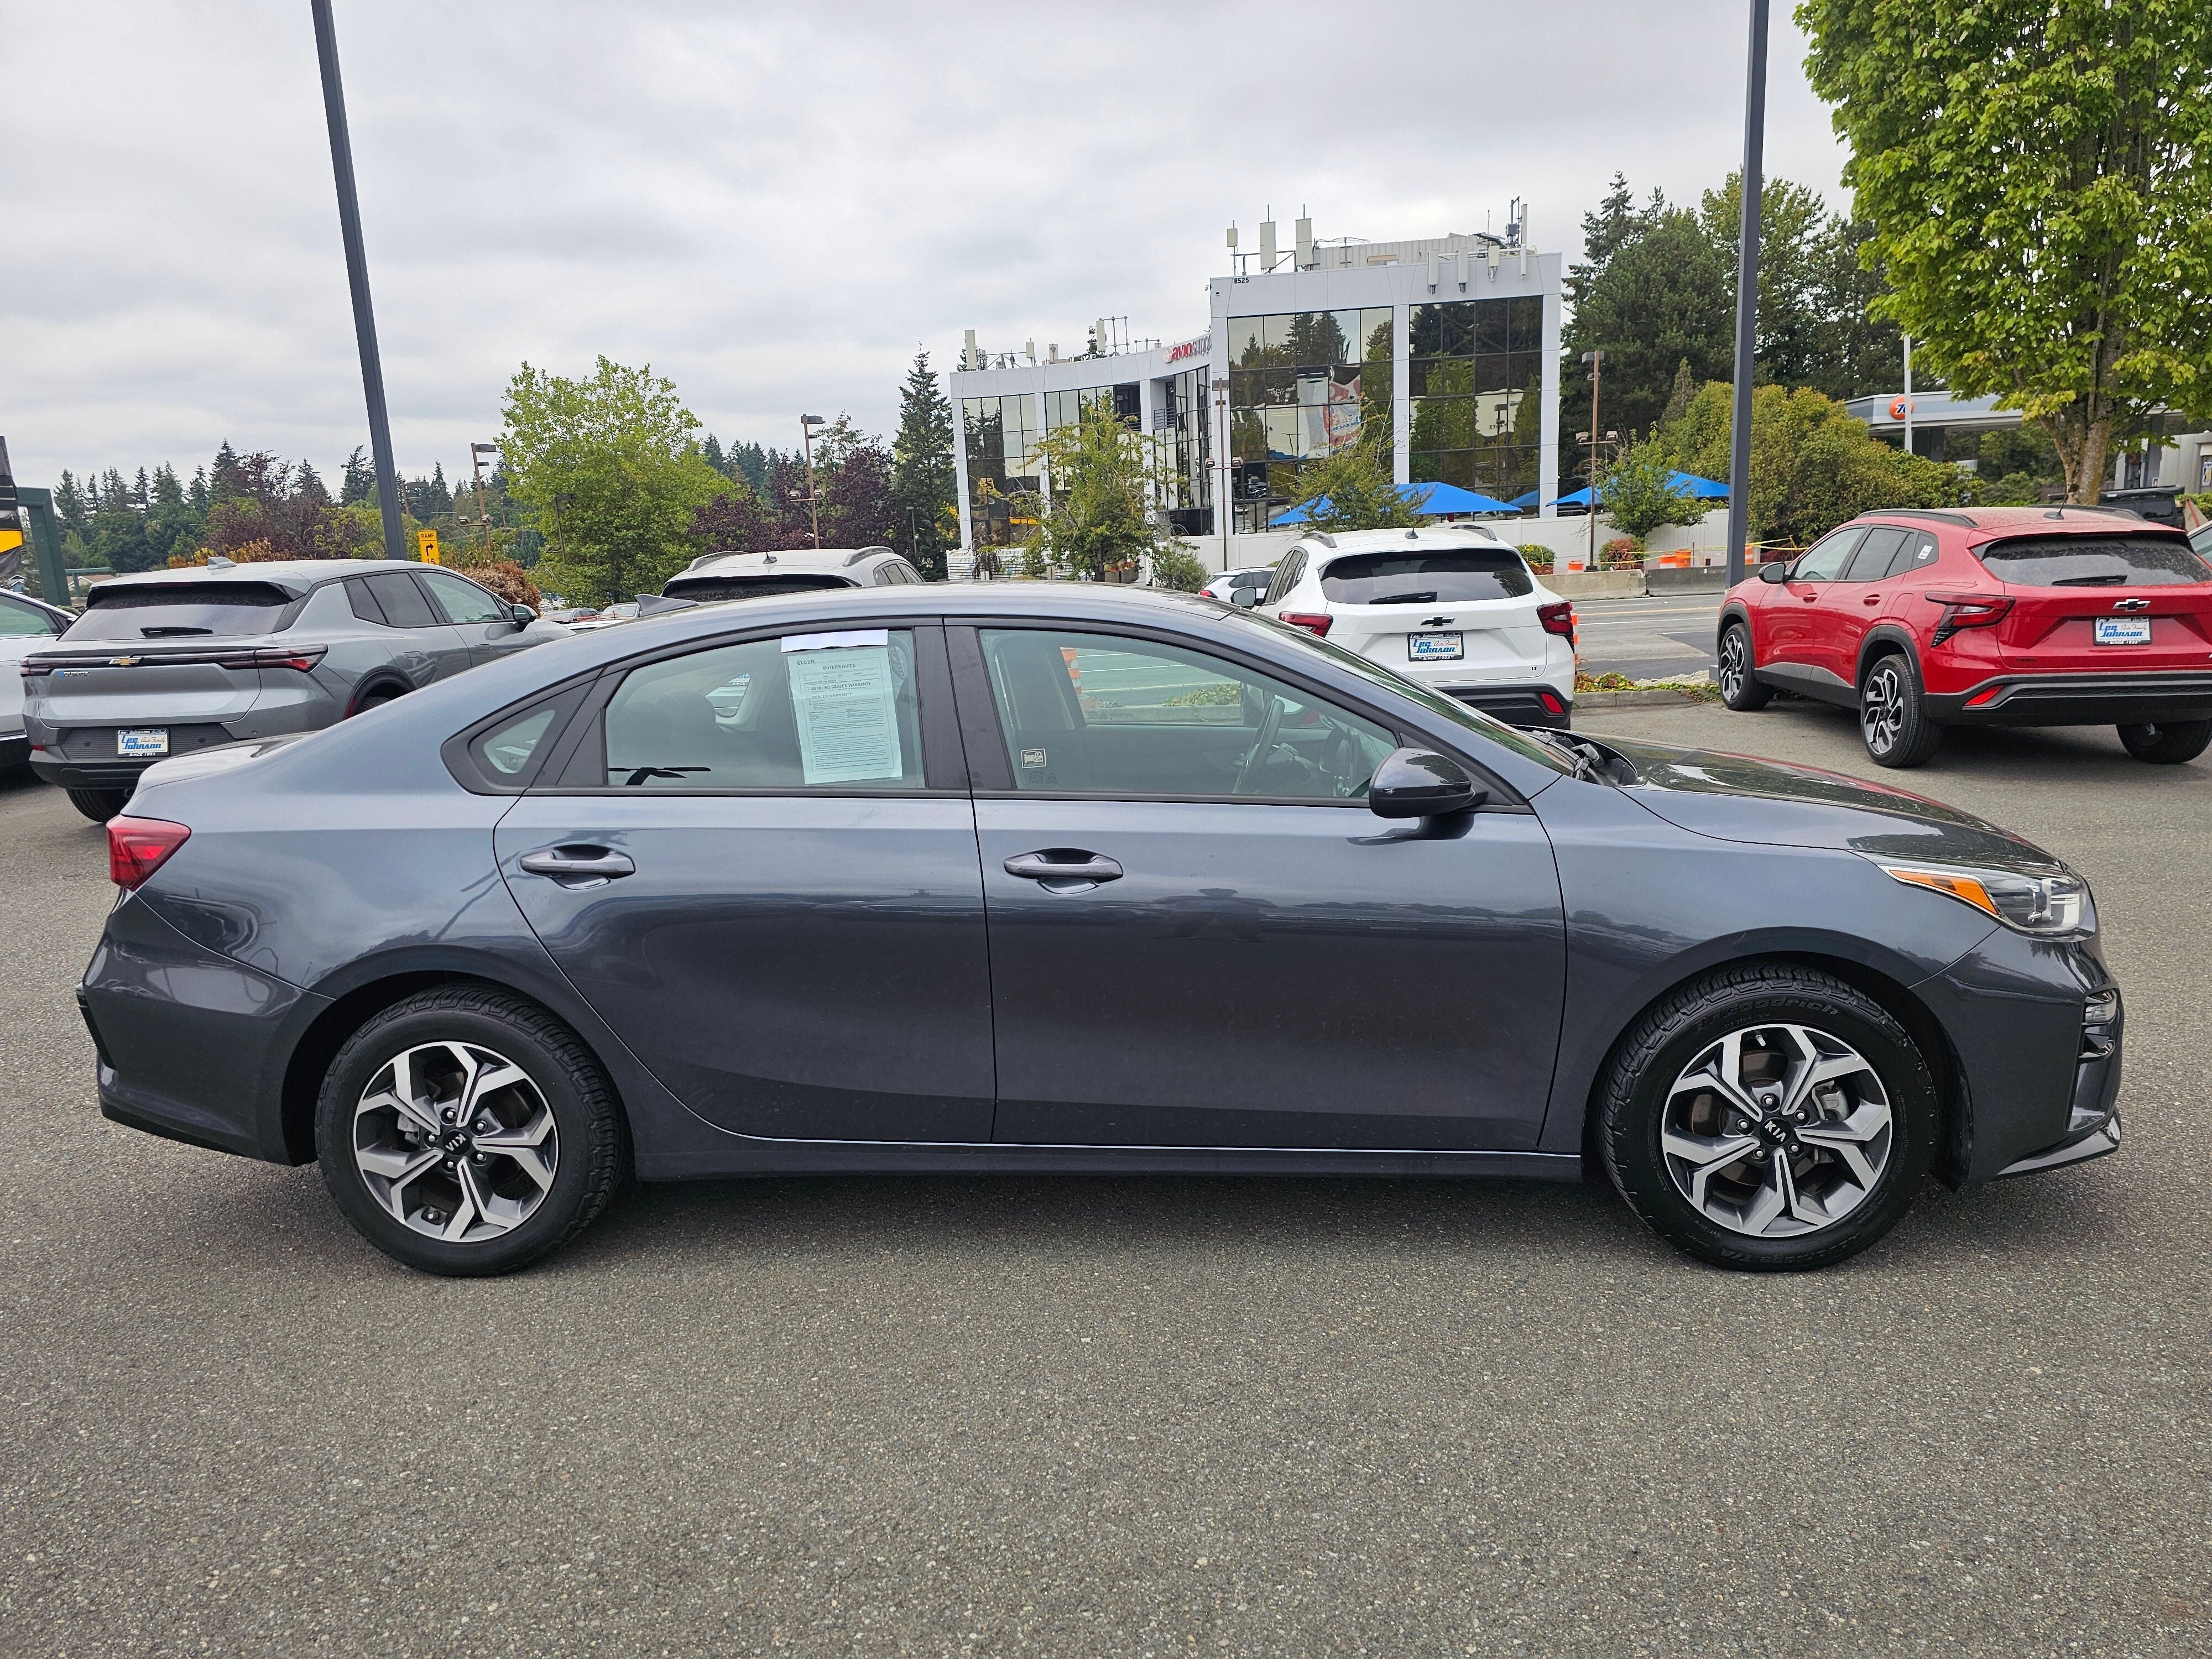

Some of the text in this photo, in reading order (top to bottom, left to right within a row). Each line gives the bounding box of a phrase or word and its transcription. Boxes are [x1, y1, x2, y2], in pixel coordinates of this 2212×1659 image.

[2099, 622, 2117, 630] Lee
[2099, 629, 2144, 637] Johnson
[1413, 639, 1432, 647] Lee
[1414, 644, 1457, 654] Johnson
[121, 734, 139, 743] Lee
[122, 741, 163, 749] Johnson
[1764, 1120, 1786, 1142] KIA
[445, 1133, 467, 1151] KIA
